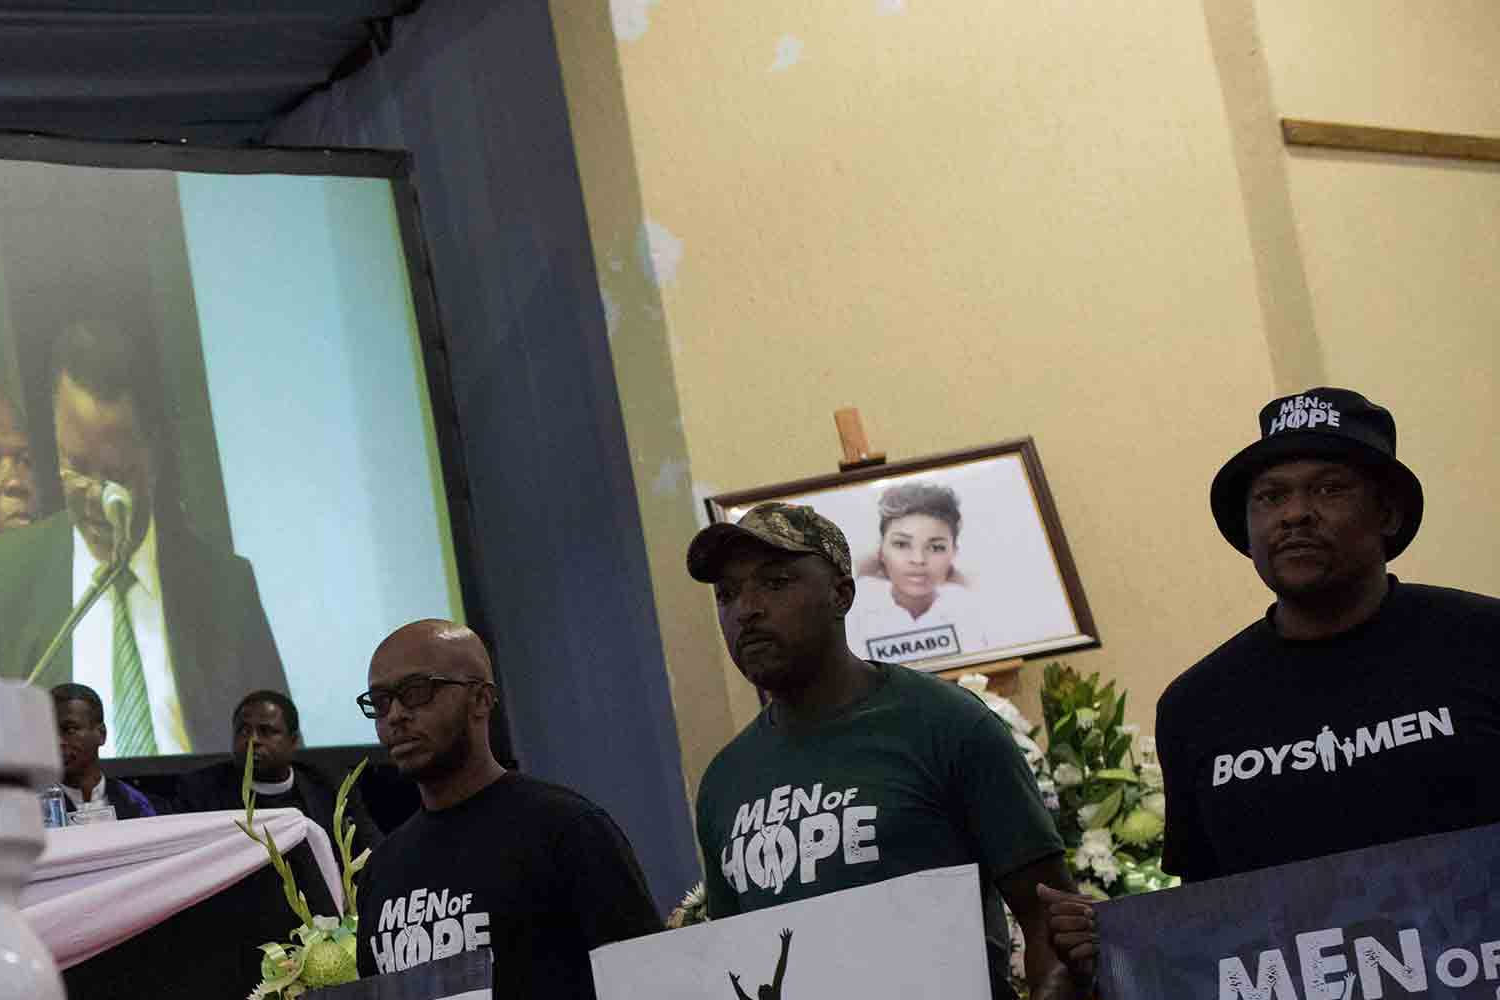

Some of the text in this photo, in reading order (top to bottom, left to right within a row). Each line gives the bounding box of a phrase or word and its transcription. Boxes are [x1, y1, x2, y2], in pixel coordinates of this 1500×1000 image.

[1269, 408, 1341, 436] HOPE
[1279, 396, 1319, 416] MEN
[876, 635, 950, 658] KARABO
[1212, 707, 1454, 787] BOYS MEN
[730, 784, 859, 840] MEN OF
[721, 805, 880, 895] HOPE
[378, 888, 473, 932] MEN OF
[370, 912, 494, 976] HOPE
